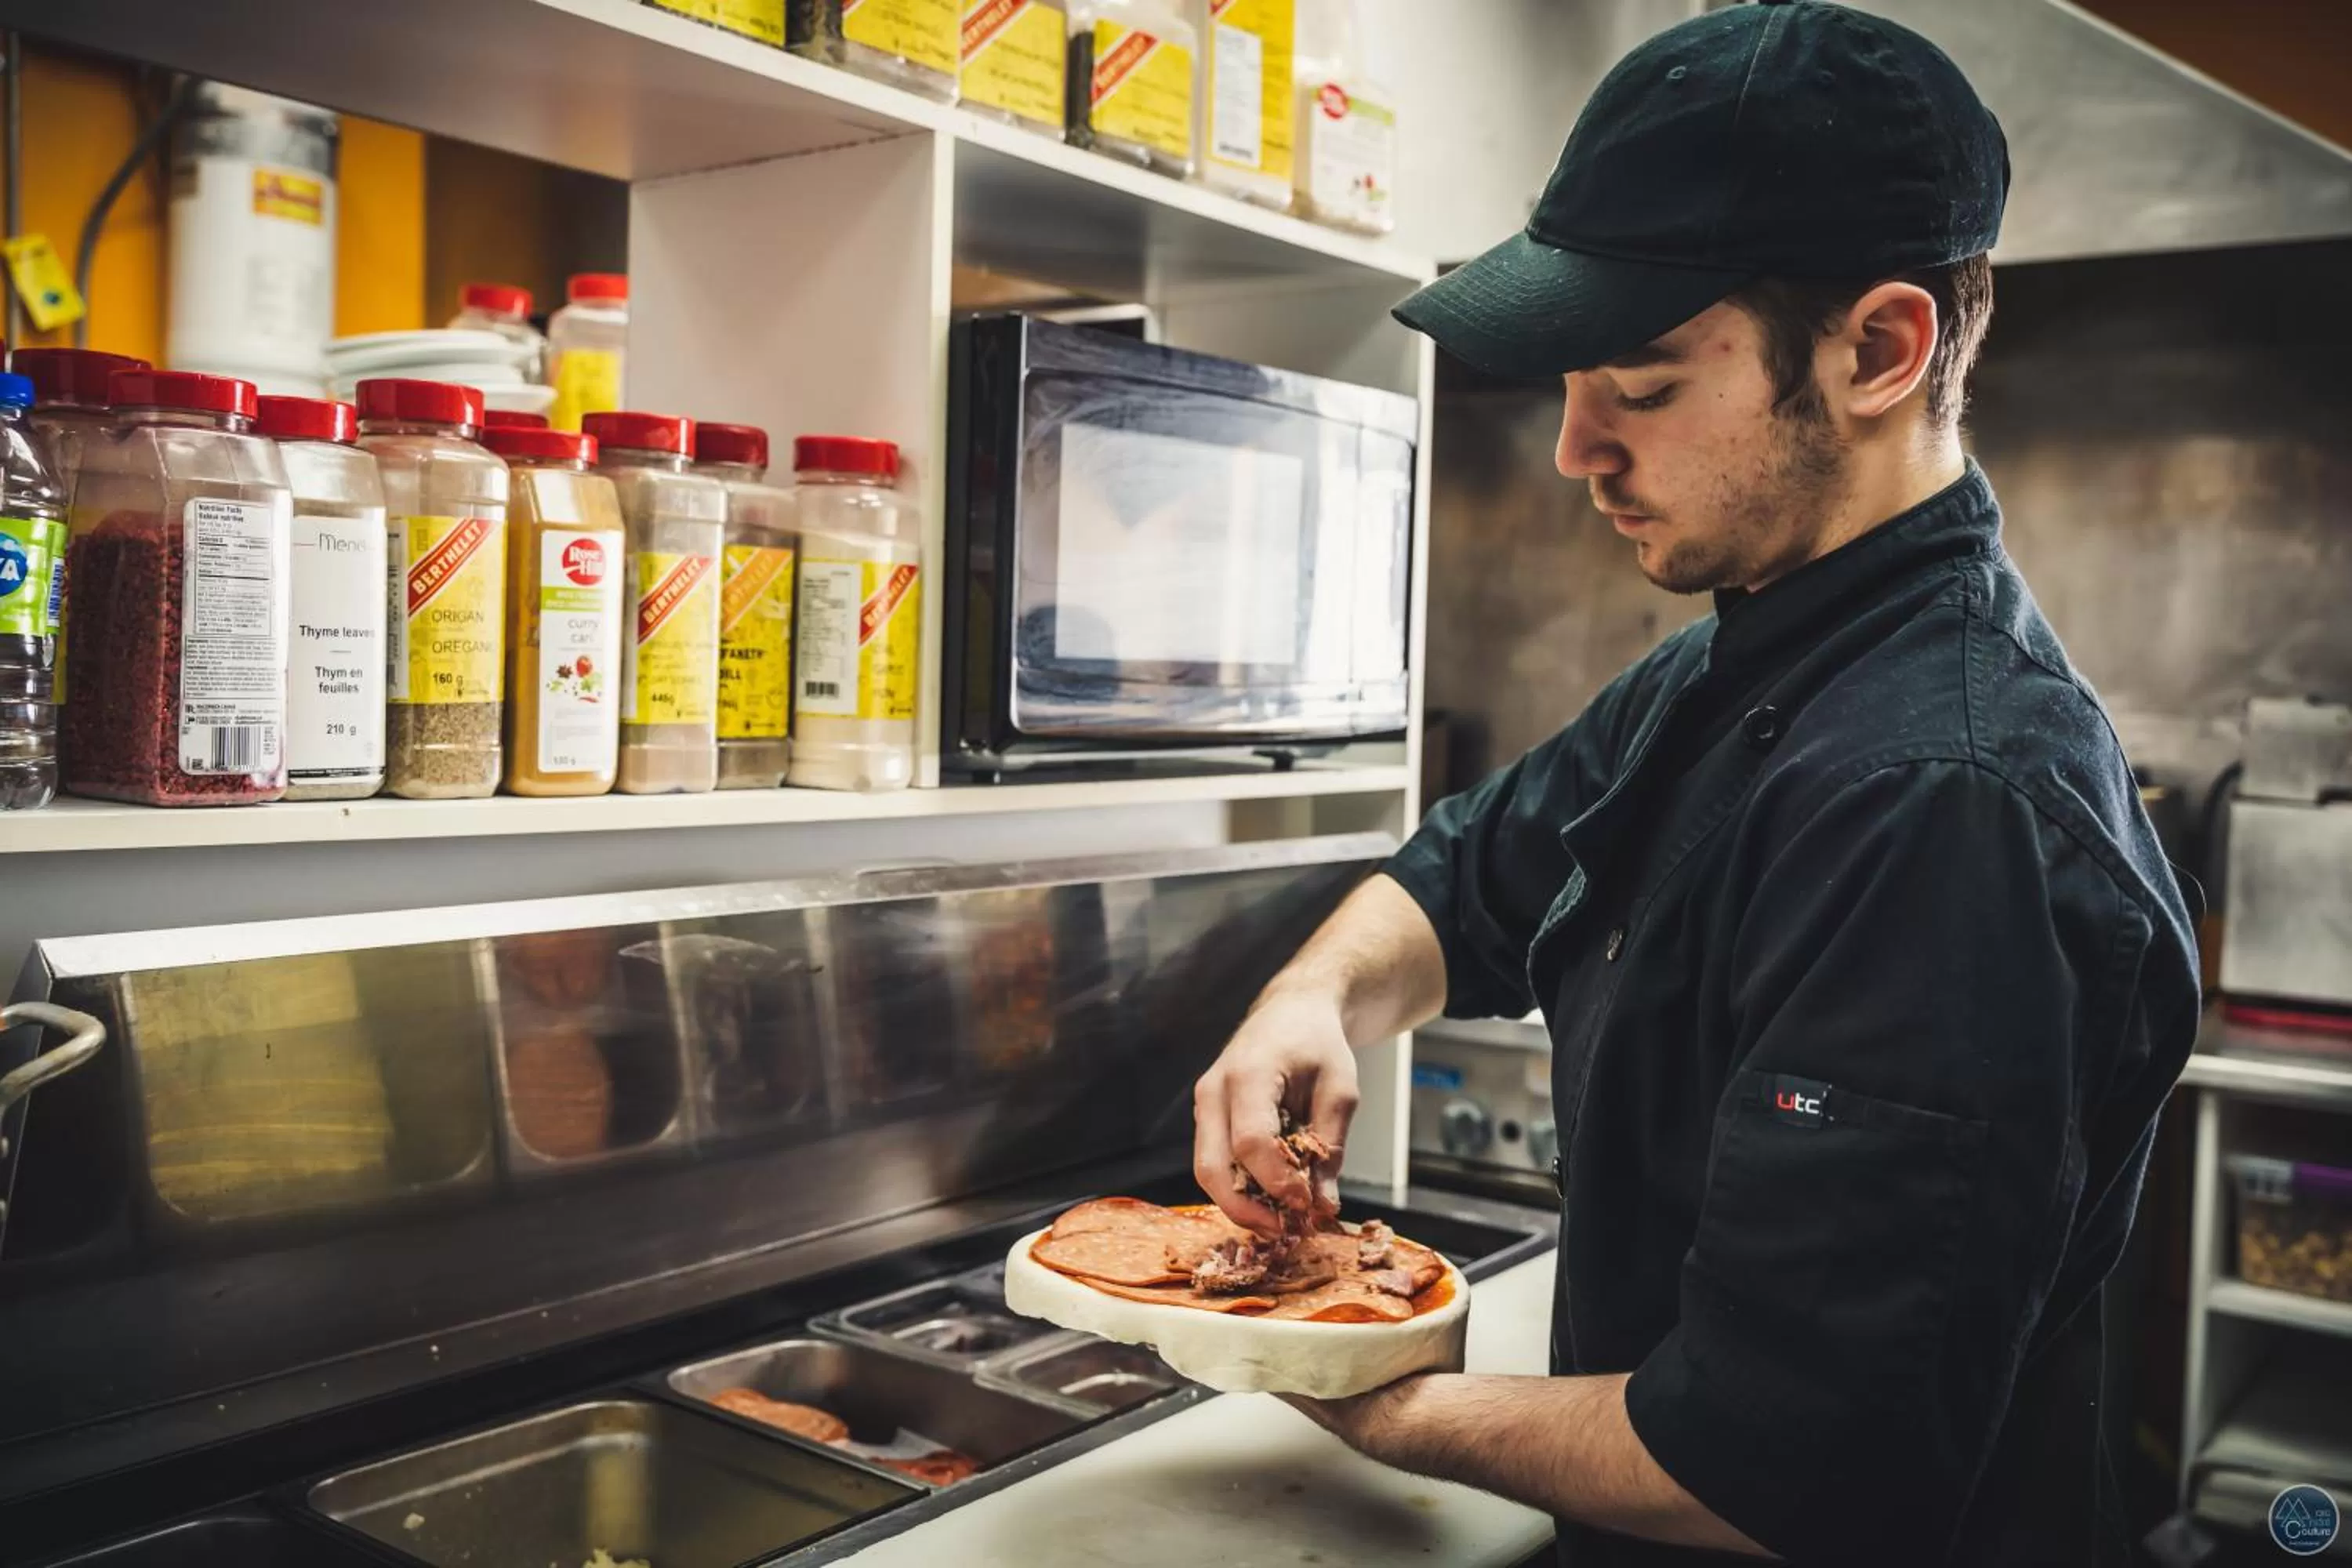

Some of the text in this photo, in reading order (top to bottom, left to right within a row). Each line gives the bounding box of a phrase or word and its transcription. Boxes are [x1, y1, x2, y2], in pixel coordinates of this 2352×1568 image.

[412, 519, 482, 595] BERTHELET
[431, 609, 484, 623] ORIGAN
[299, 624, 339, 641] Thyme
[431, 639, 492, 654] OREGAN
[314, 666, 363, 681] Thym en
[432, 672, 452, 684] 160
[319, 681, 361, 694] feuilles
[326, 723, 358, 737] 210 g
[1777, 1092, 1820, 1114] utc
